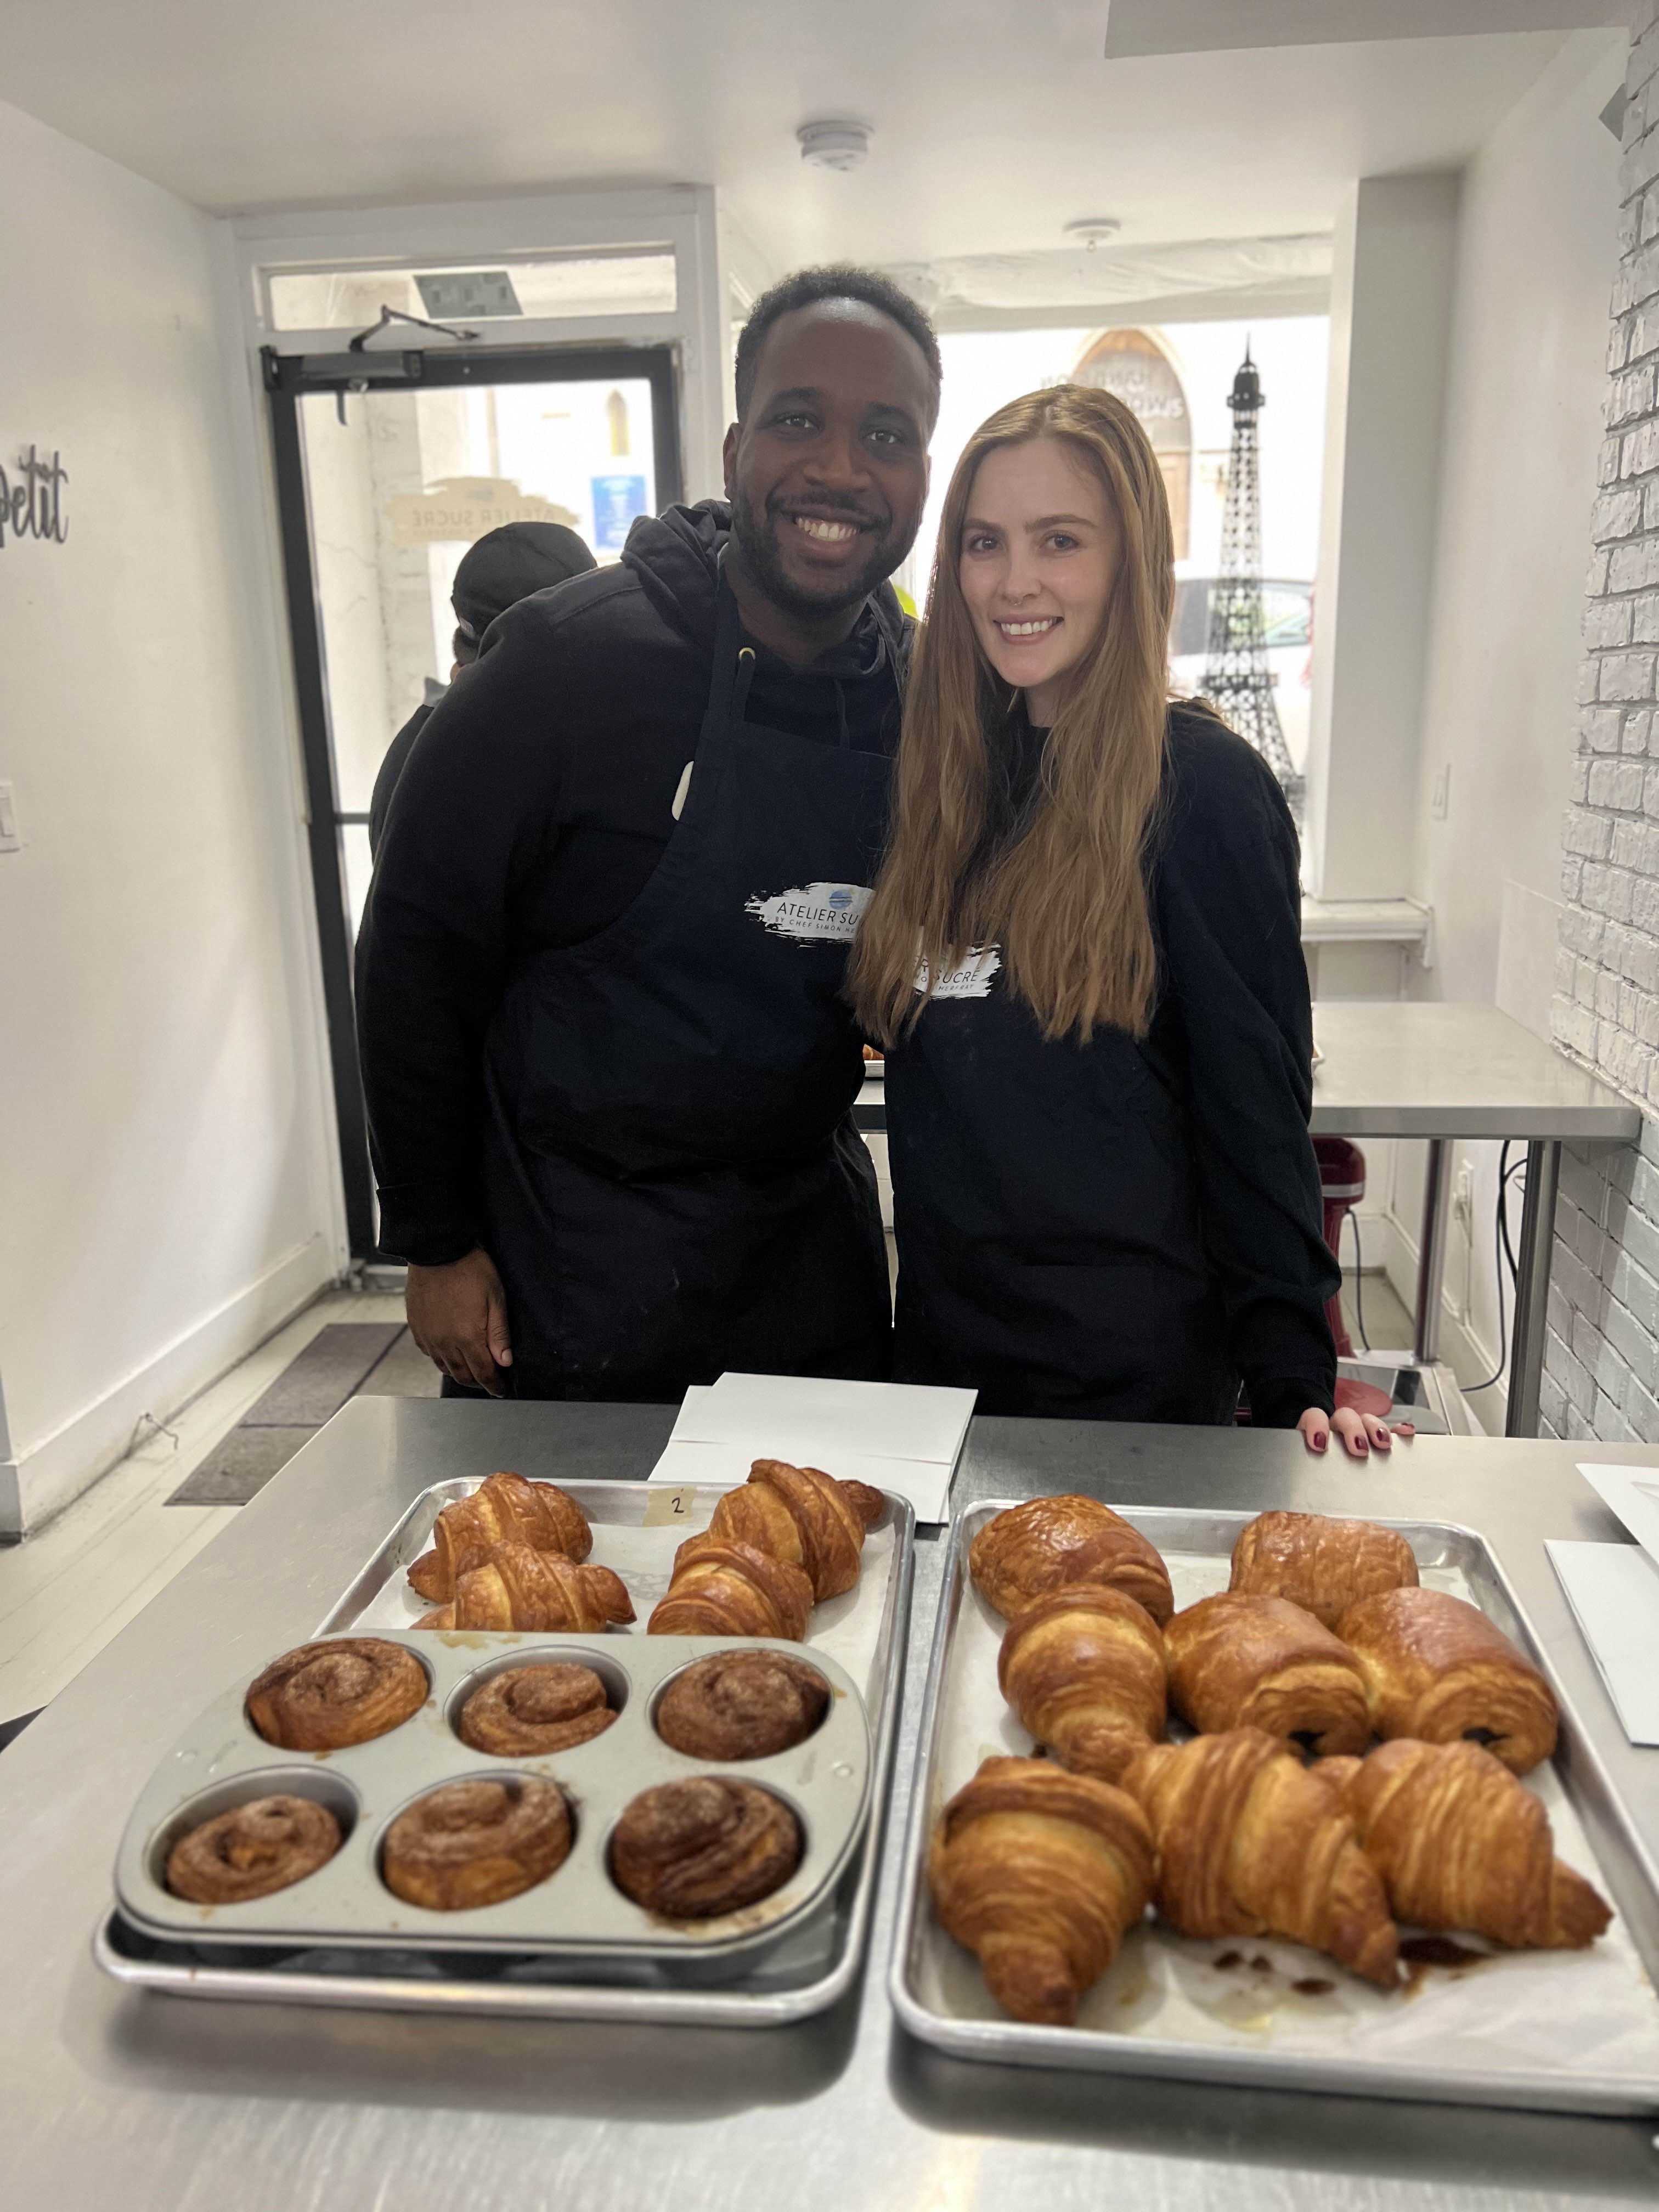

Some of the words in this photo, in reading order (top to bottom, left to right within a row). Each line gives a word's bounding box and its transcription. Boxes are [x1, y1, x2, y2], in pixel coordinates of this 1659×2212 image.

[777, 902, 836, 922] ATELIER
[789, 919, 812, 928] CHEF
[816, 923, 841, 932] SIMON
[672, 1497, 685, 1514] 2
